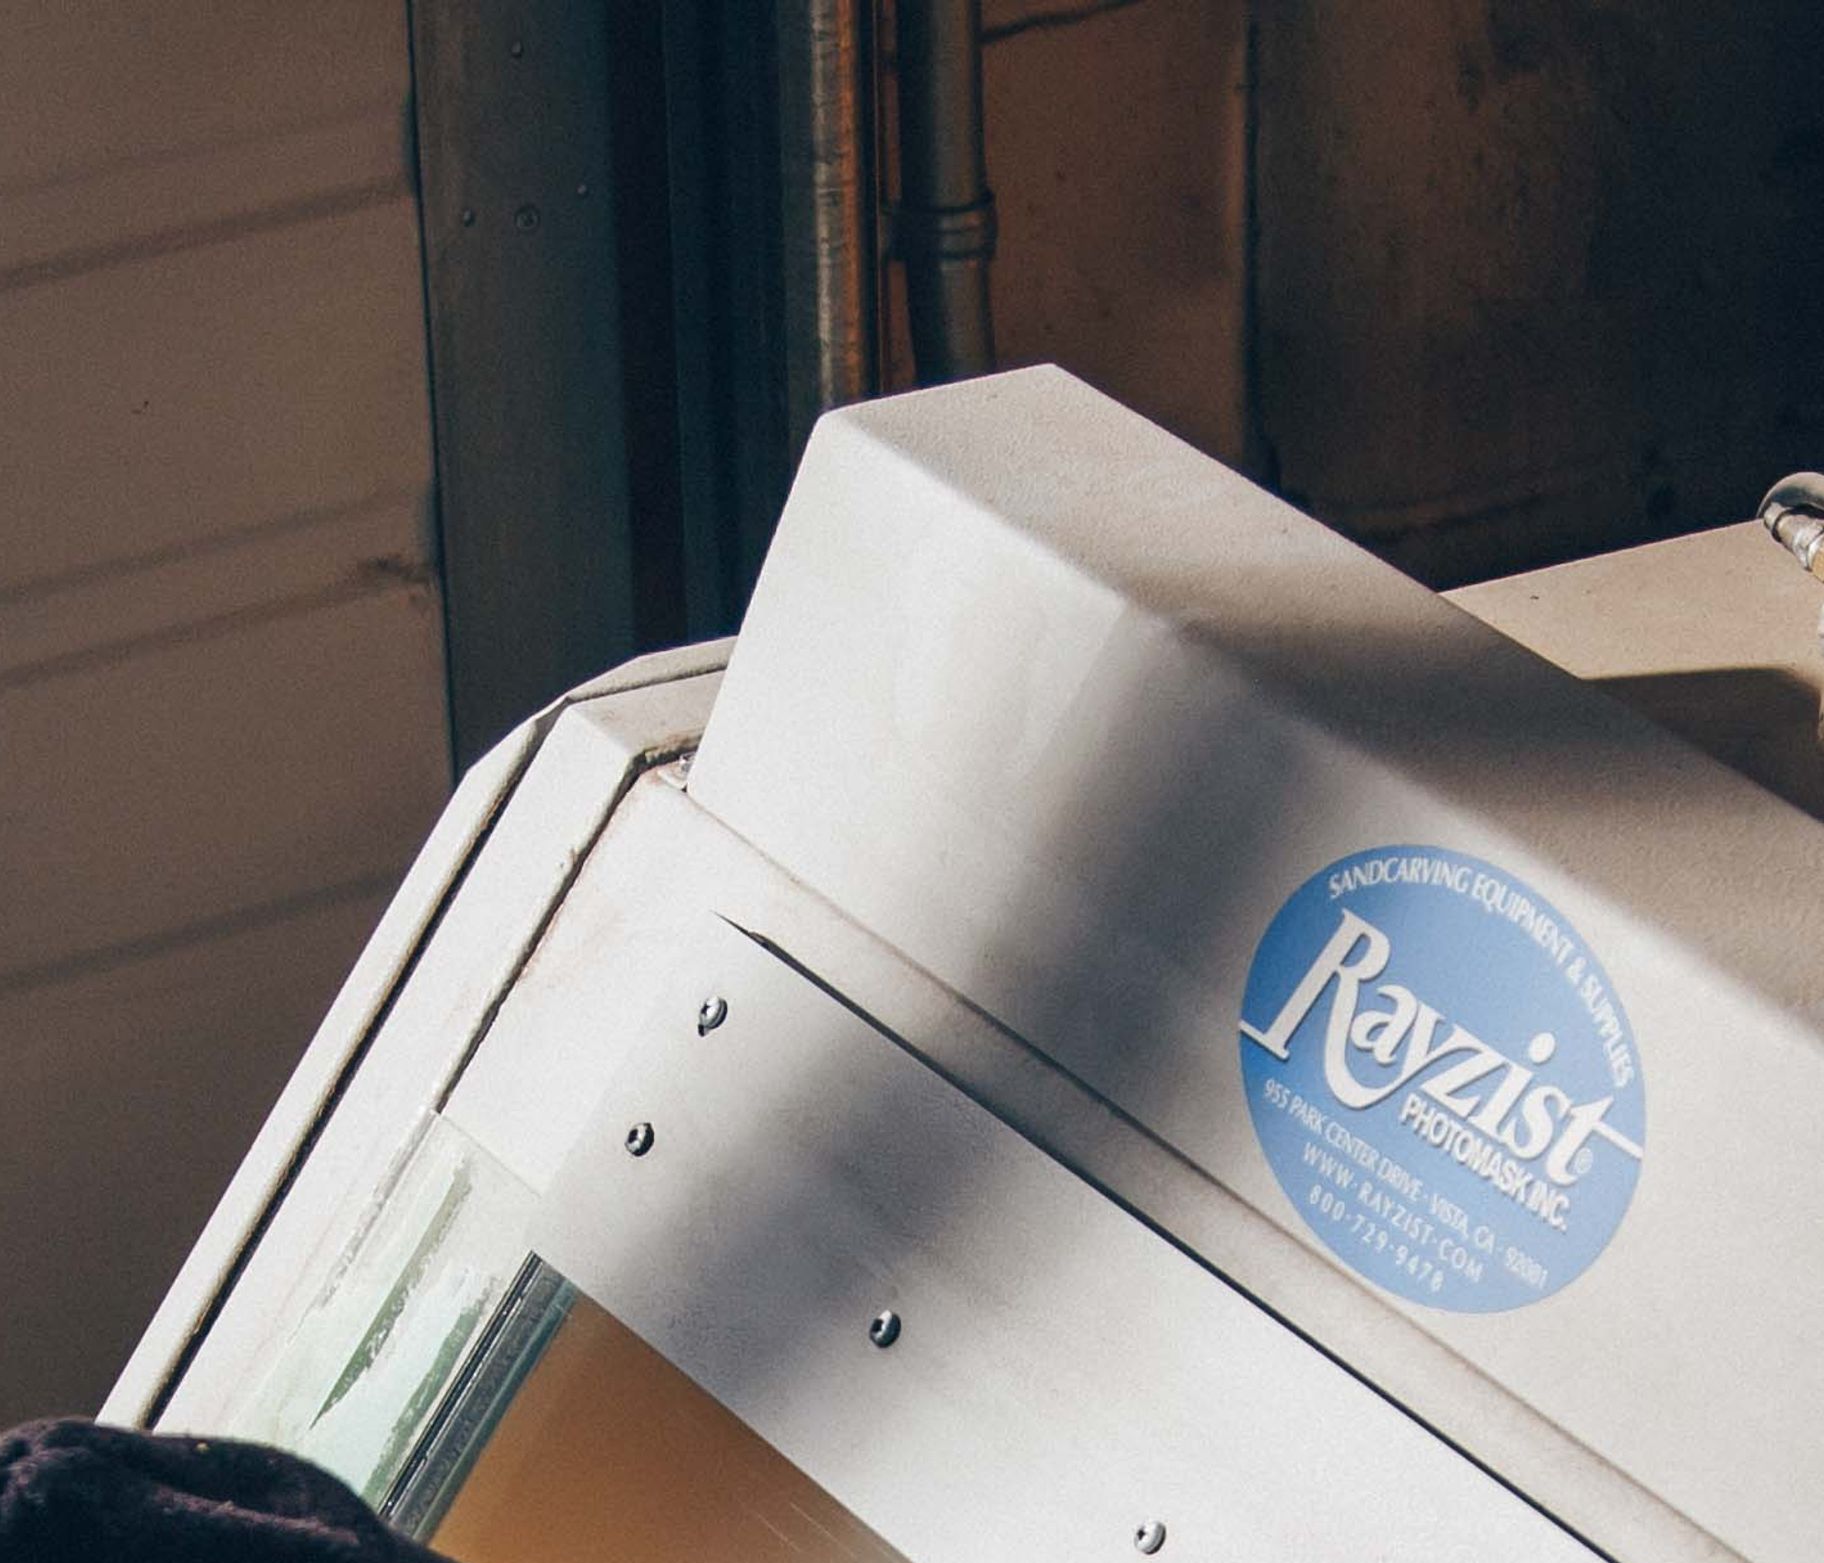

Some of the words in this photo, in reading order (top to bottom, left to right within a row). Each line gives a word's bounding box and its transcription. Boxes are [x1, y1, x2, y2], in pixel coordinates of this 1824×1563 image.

[1239, 906, 1643, 1190] Rayzist
[1329, 856, 1471, 899] SANDCARVING
[1472, 873, 1570, 970] EQUIPMENT
[1564, 956, 1584, 983] &
[1580, 971, 1637, 1089] SUPPLIES
[1262, 1077, 1291, 1113] 955
[1288, 1096, 1328, 1140] PARK
[1325, 1122, 1383, 1174] CENTER
[1378, 1156, 1424, 1203] DRIVE
[1474, 1224, 1495, 1255] CA
[1399, 1091, 1534, 1206] PHOTOMASK
[1522, 1172, 1570, 1232] INC.
